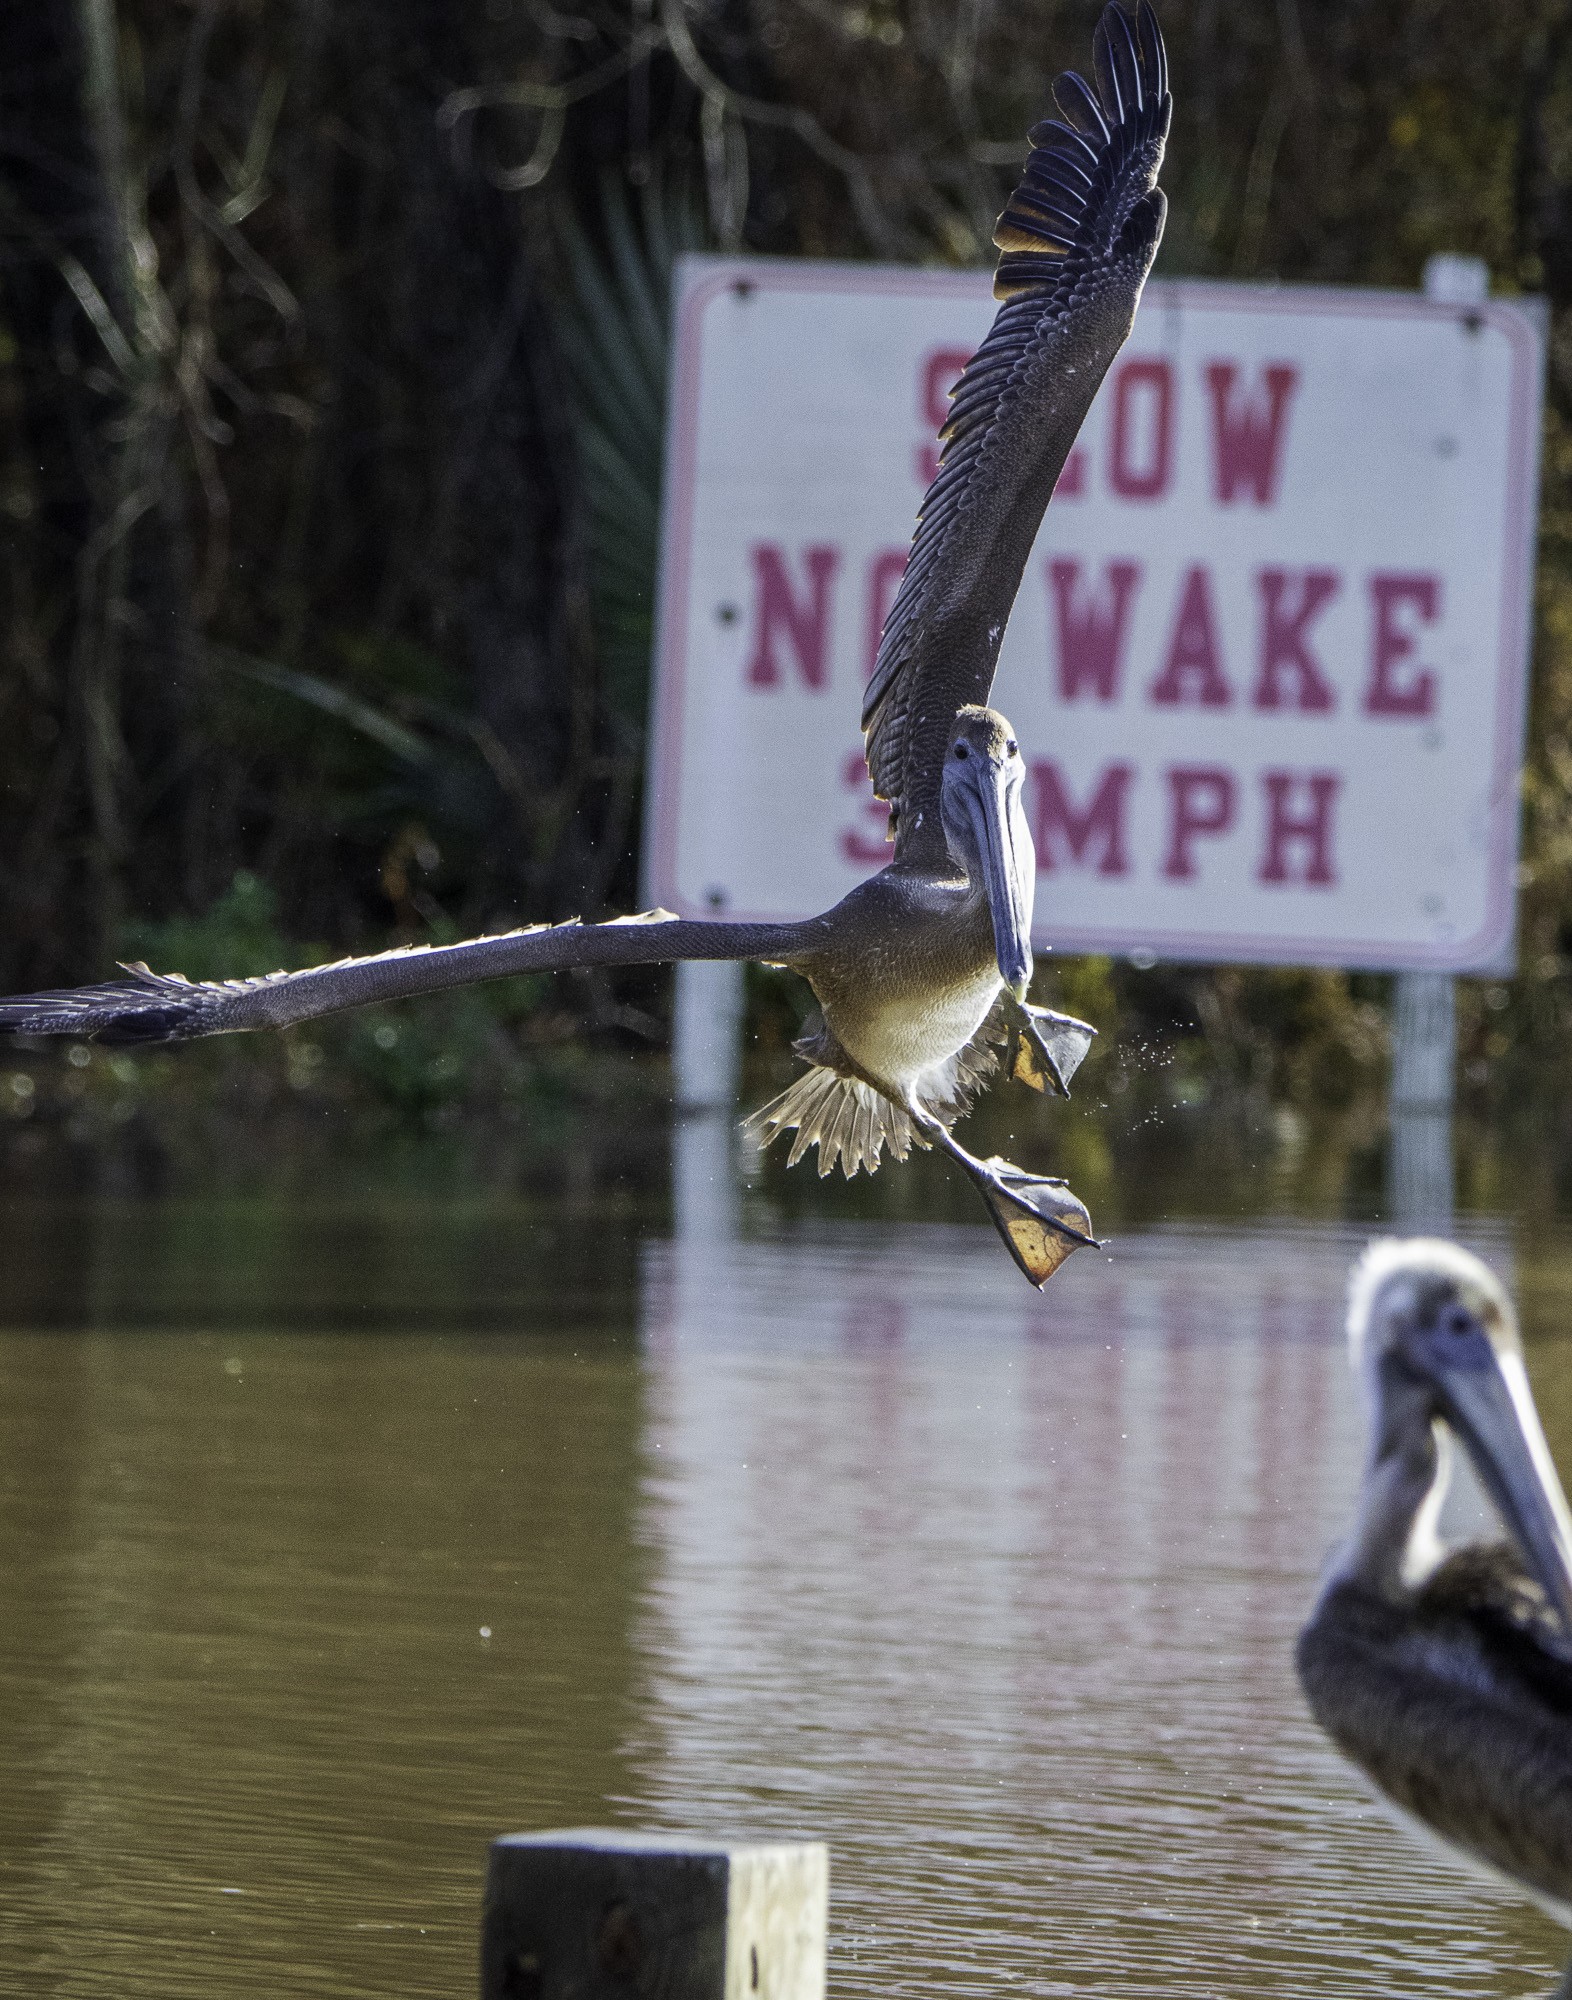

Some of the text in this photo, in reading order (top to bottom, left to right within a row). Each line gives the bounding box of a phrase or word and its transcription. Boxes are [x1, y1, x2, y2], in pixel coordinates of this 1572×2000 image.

[917, 350, 1297, 506] SOW
[1046, 555, 1439, 716] WAKE
[1030, 758, 1338, 886] MPH
